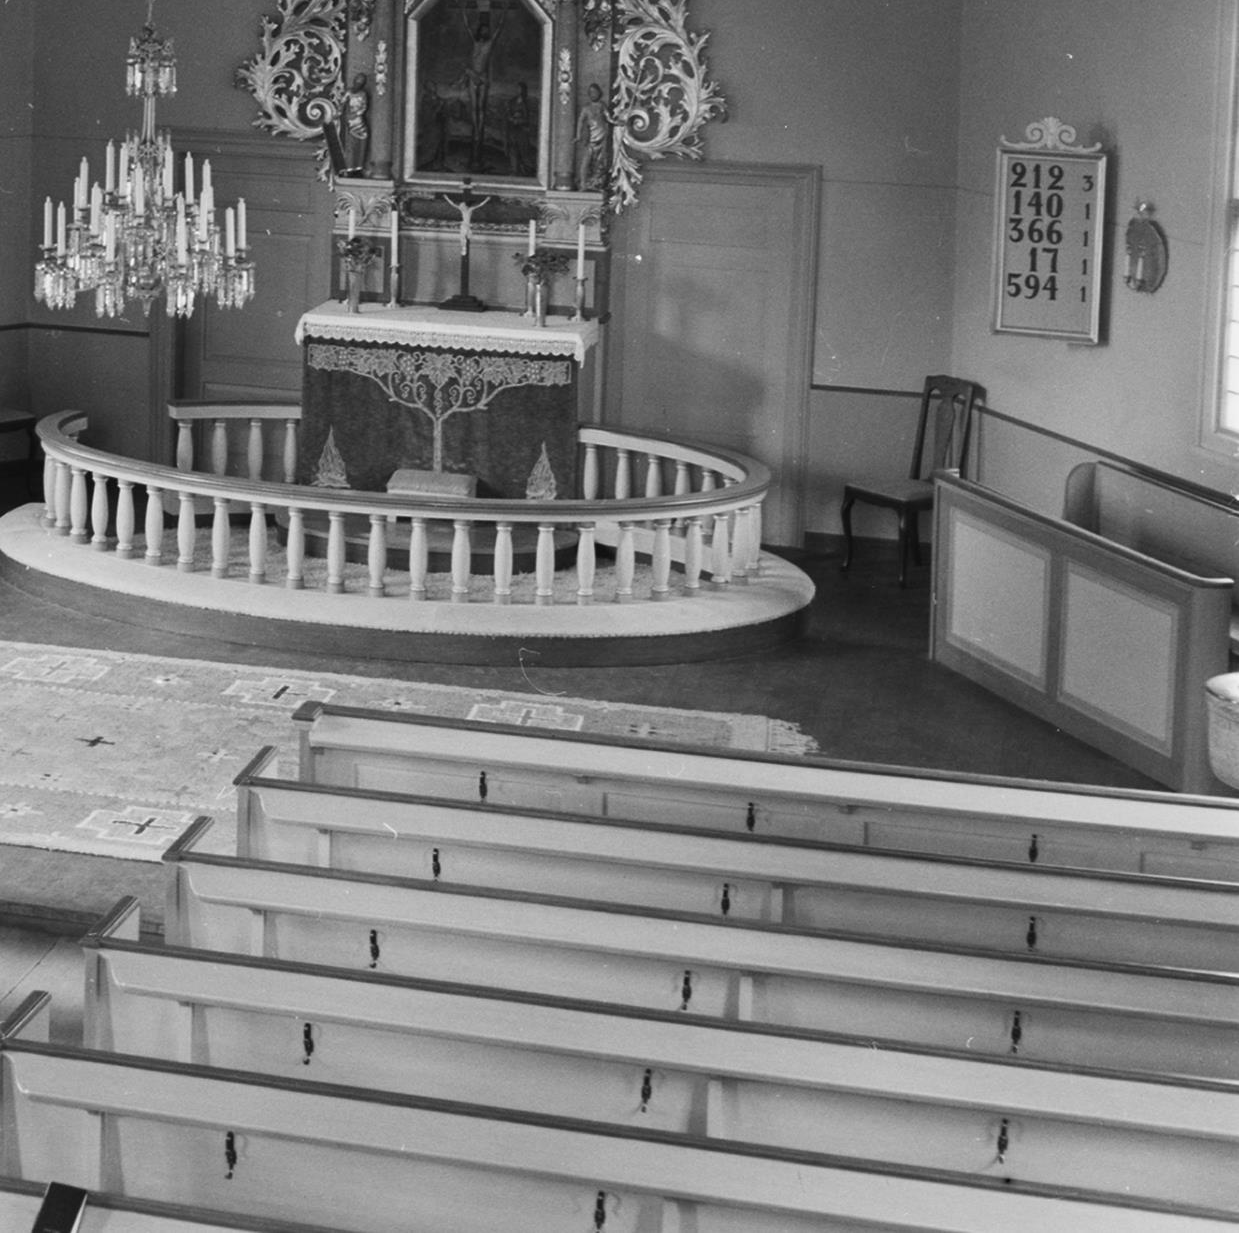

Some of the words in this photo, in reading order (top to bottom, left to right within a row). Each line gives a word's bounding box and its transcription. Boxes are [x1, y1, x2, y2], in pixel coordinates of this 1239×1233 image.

[1011, 162, 1064, 190] 212
[1082, 175, 1094, 192] 3
[1013, 190, 1063, 218] 140
[1085, 203, 1090, 220] 1
[1009, 218, 1062, 244] 366
[1083, 231, 1088, 247] 1
[1029, 247, 1058, 273] 17
[1082, 259, 1088, 275] 1
[1007, 273, 1058, 300] 594
[1080, 286, 1086, 302] 1
